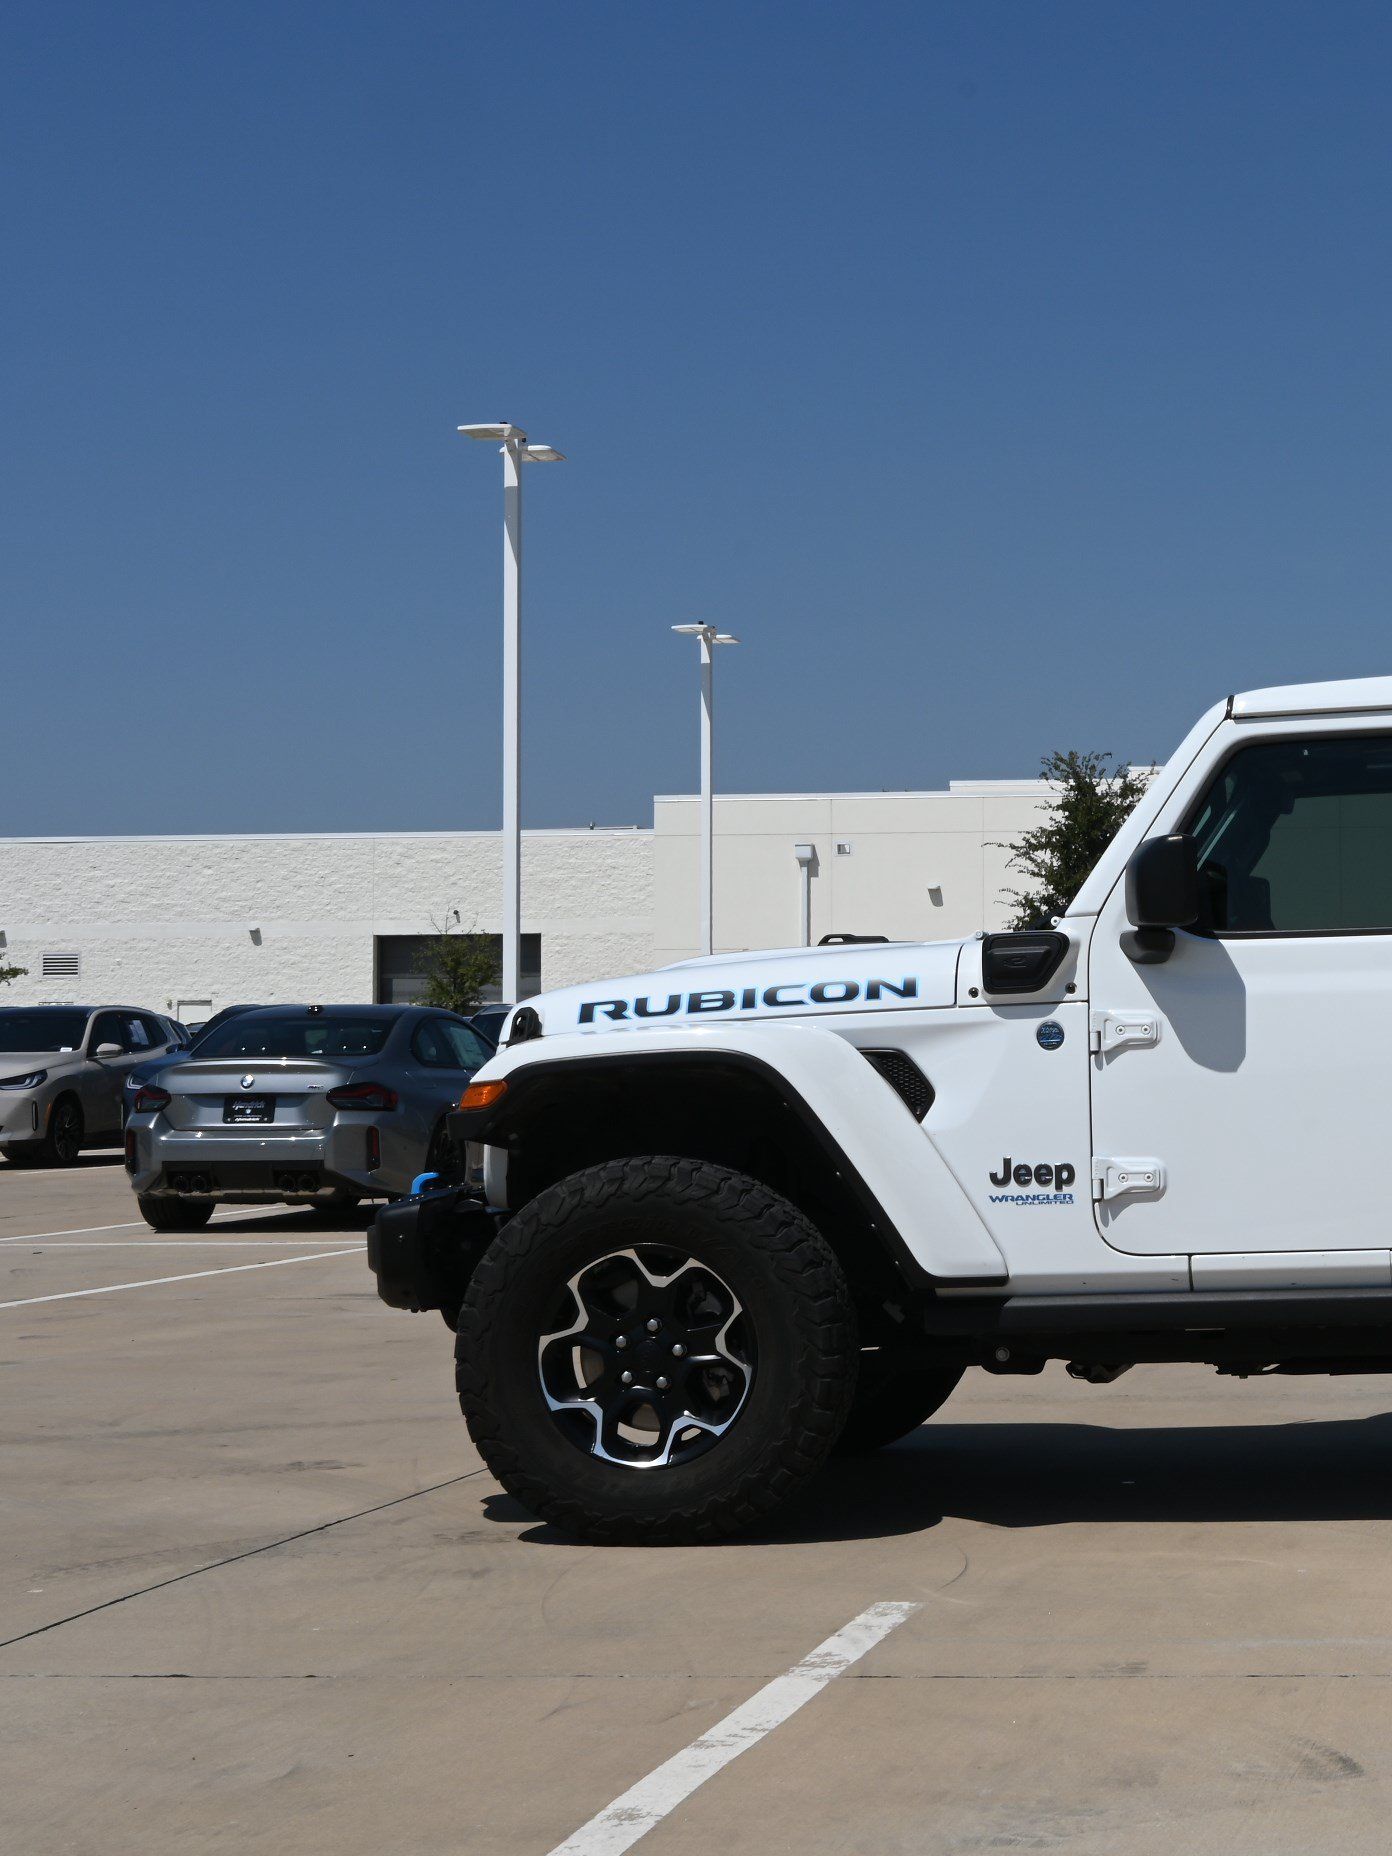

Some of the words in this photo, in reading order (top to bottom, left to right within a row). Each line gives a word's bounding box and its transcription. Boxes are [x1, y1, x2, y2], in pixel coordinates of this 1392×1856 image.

[577, 976, 919, 1024] RUBICON
[989, 1155, 1076, 1192] Jeep
[989, 1193, 1074, 1203] WRANGLER
